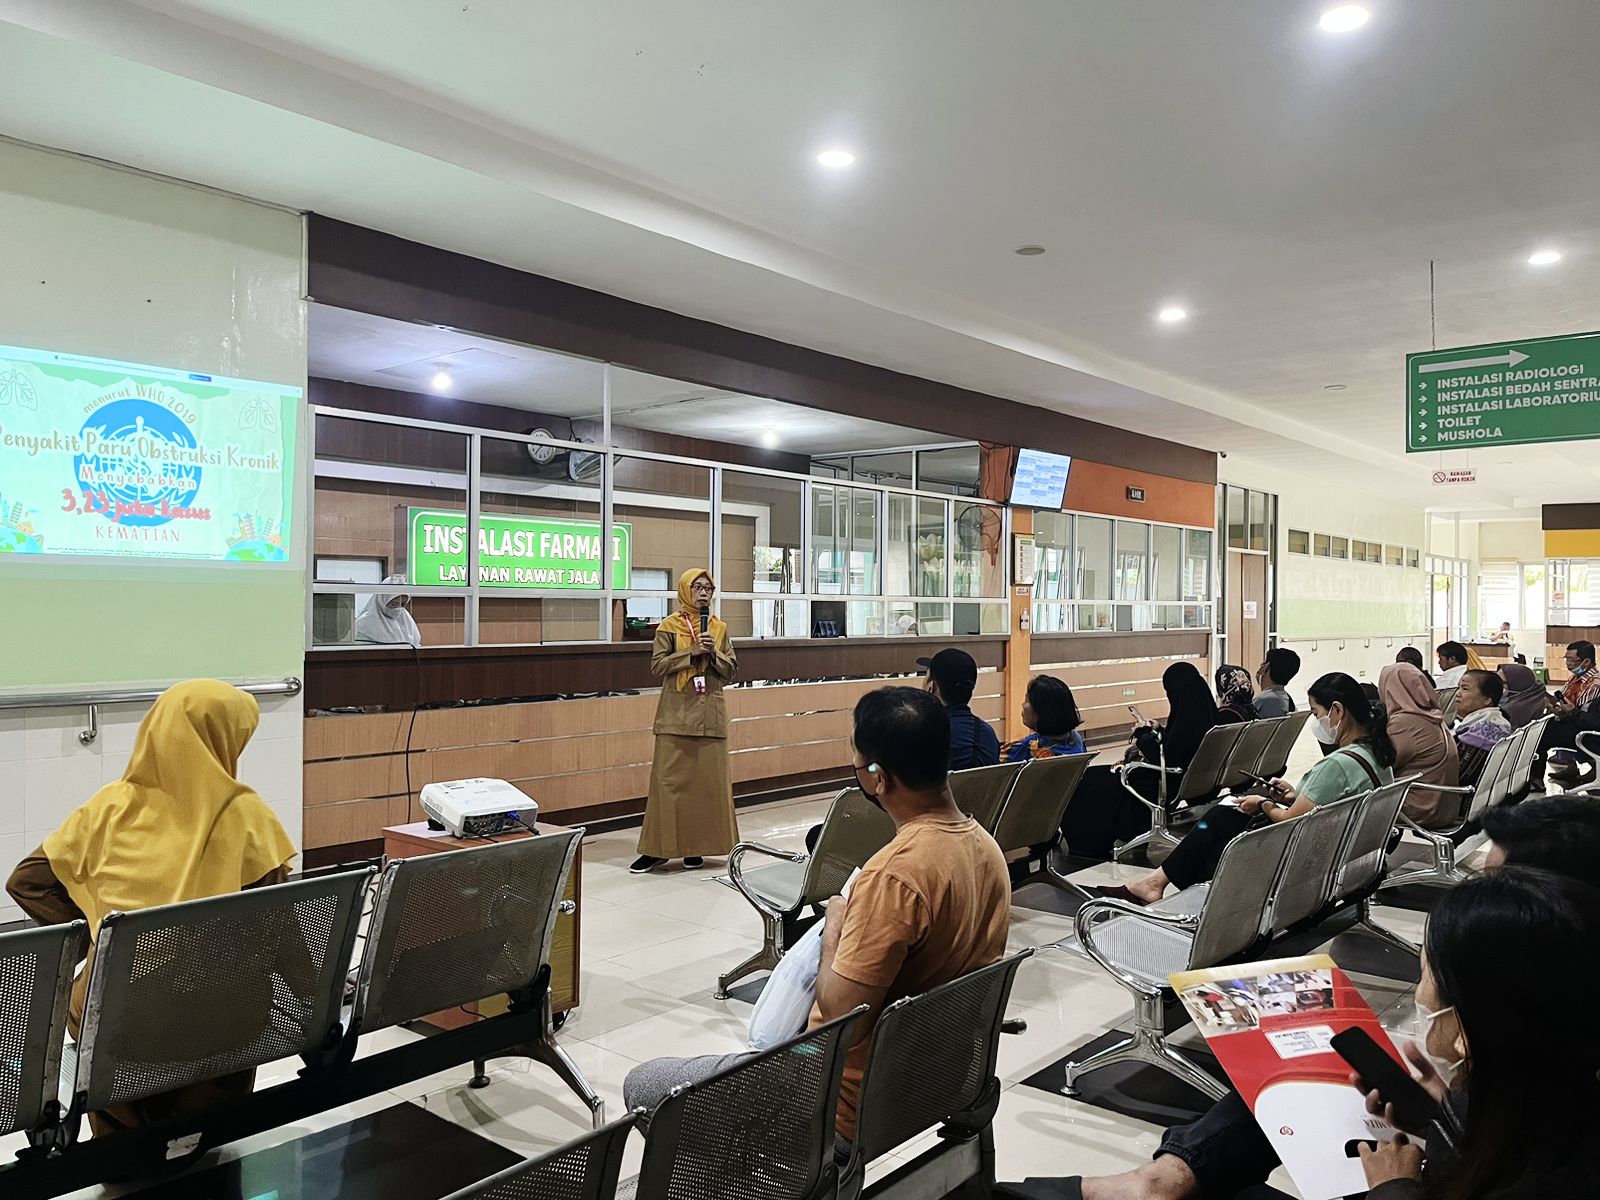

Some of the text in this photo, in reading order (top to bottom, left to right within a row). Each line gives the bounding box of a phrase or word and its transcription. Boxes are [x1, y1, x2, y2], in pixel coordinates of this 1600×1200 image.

[1437, 364, 1584, 389] INSTALASI RADIOLOGI
[1437, 386, 1503, 402] INSTALASI
[1505, 380, 1551, 395] BEDAH
[83, 384, 197, 424] menurut WHO 2019
[1437, 400, 1503, 415] INSTALASI
[1437, 415, 1482, 428] TOILET
[1437, 427, 1503, 442] MUSHOLA
[0, 424, 280, 470] enyakit Paru Obstruksi Kronik
[81, 465, 196, 488] Menyebabkan
[61, 488, 109, 515] 3,23
[96, 525, 181, 542] KEMATIAN
[423, 524, 621, 561] INSALASI FARMAI
[439, 564, 600, 585] LAYNAN RAWAT JALA
